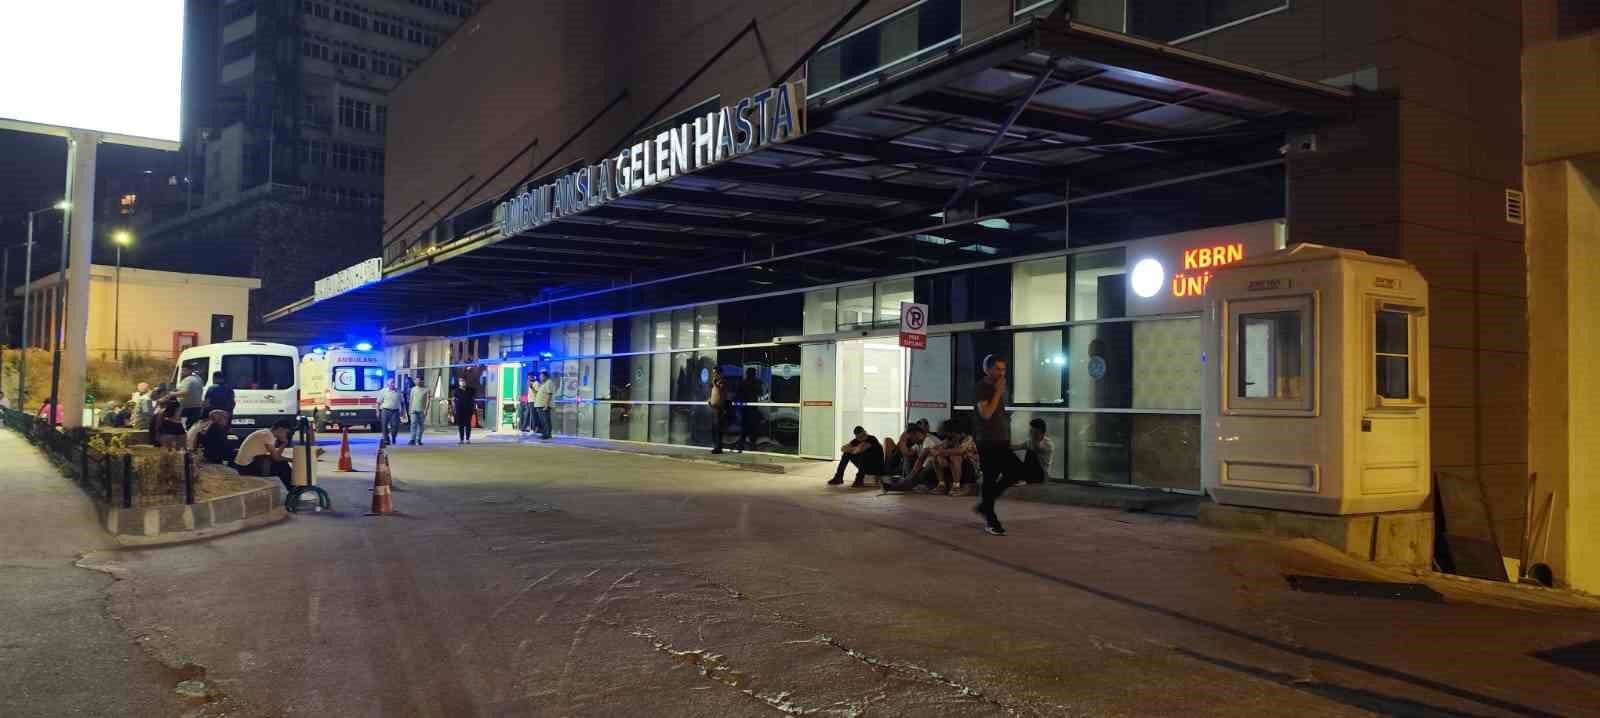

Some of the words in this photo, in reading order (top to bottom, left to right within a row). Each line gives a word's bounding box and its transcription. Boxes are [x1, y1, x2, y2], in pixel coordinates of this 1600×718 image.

[499, 158, 613, 236] AMBULANSLA
[615, 122, 688, 195] GELEN
[694, 81, 803, 168] HASTA
[1184, 244, 1244, 270] KBRN
[1172, 272, 1213, 297] ÜNİ
